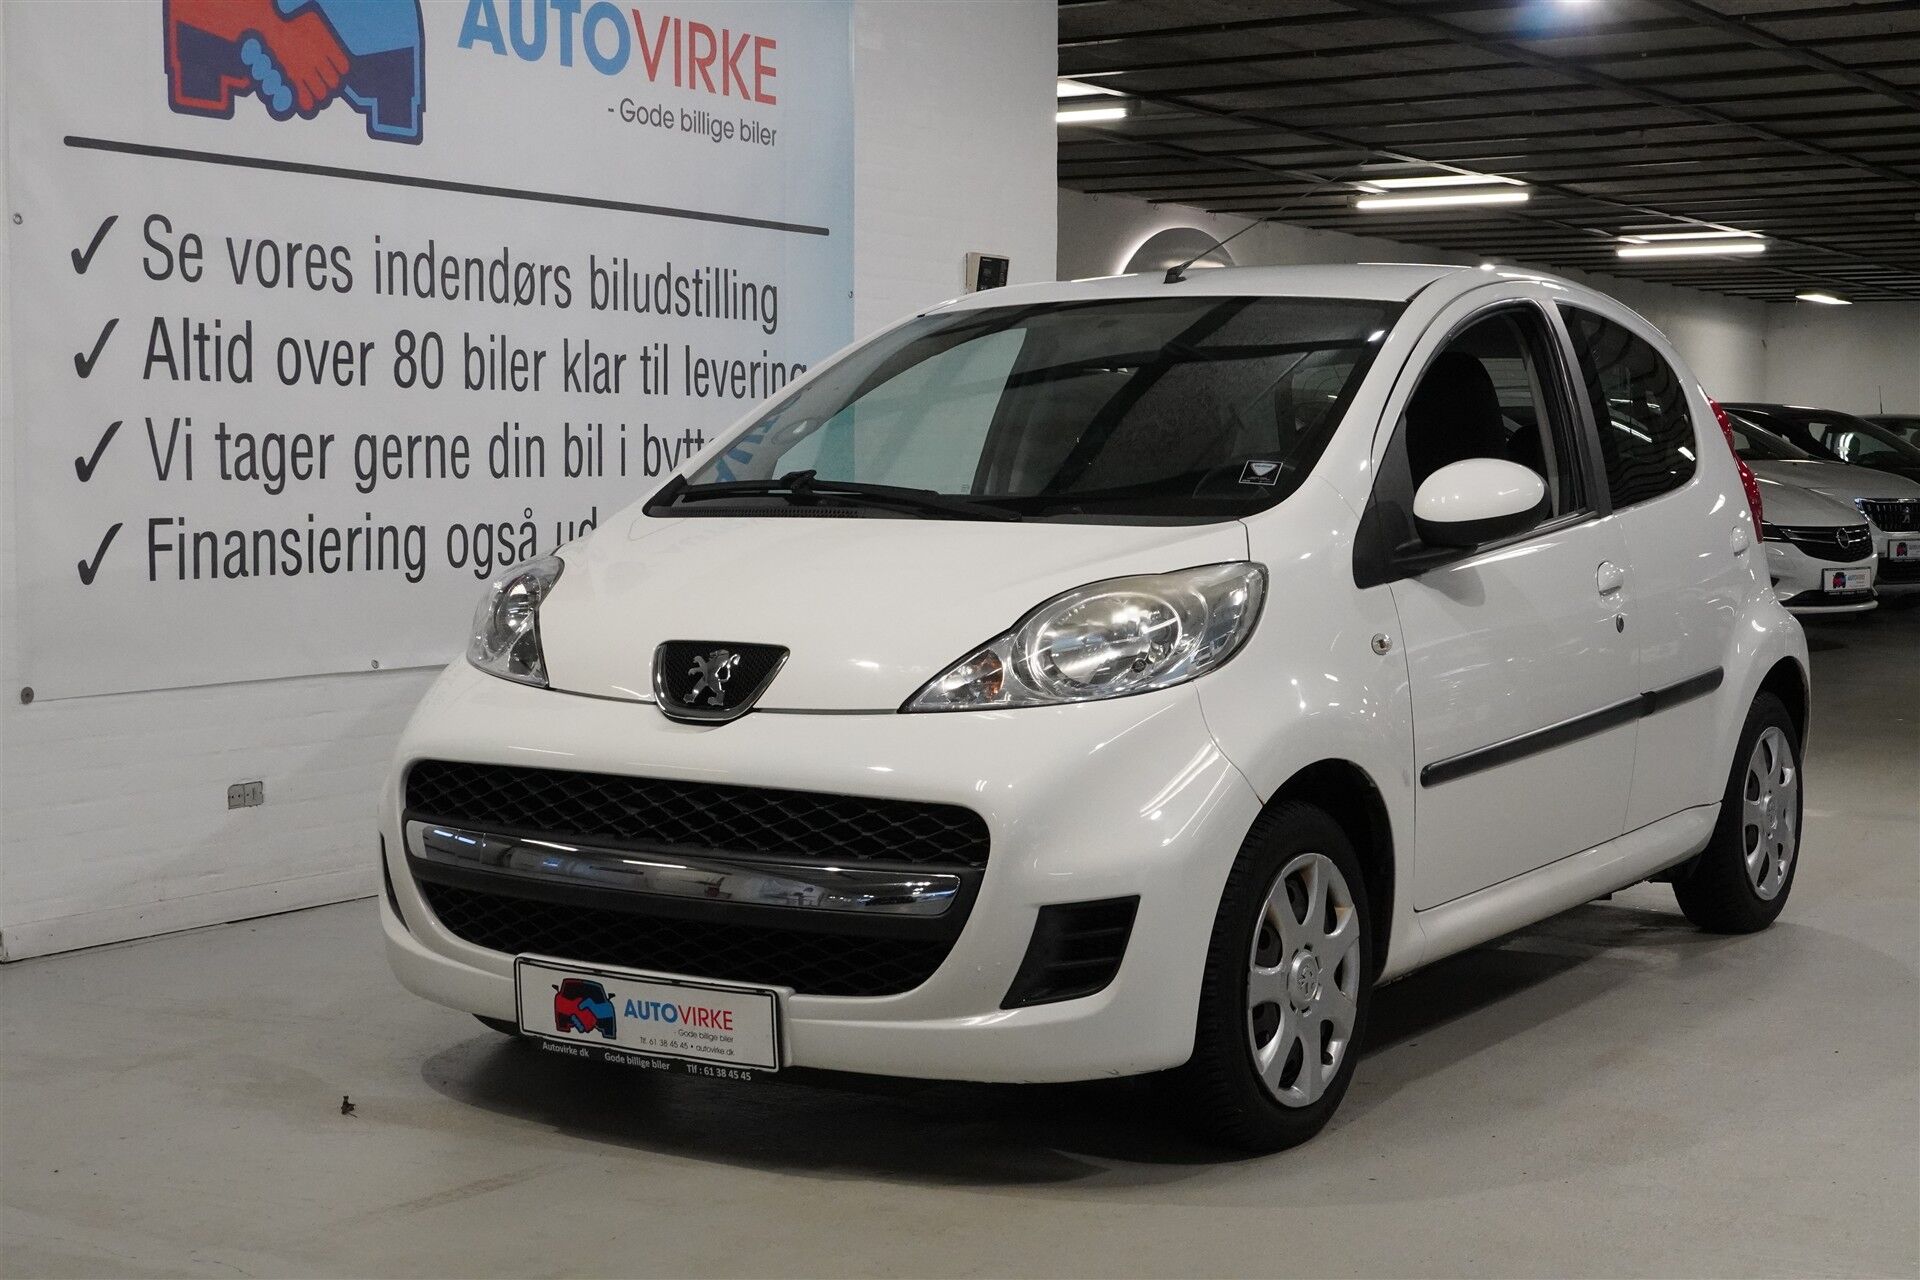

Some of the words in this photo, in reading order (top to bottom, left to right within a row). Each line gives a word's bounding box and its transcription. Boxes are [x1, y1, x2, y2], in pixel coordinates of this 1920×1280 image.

[457, 0, 777, 106] AUTOVIRKE
[619, 97, 675, 129] Gode
[680, 107, 735, 143] billige
[740, 118, 777, 147] biler
[143, 214, 203, 283] Se
[225, 236, 354, 294] vores
[374, 234, 572, 309] indendørs
[590, 254, 778, 336] biludstilling
[142, 317, 253, 384] Altid
[276, 336, 375, 387] over
[393, 329, 444, 390] 80
[463, 331, 547, 393] biler
[563, 337, 627, 396] klar
[639, 343, 669, 397] til
[145, 416, 193, 482] Vi
[214, 422, 335, 496] tager
[354, 433, 470, 495] gerne
[488, 421, 545, 480] din
[564, 422, 603, 479] bil
[620, 423, 626, 477] i
[148, 511, 426, 584] Finansiering
[446, 507, 537, 581] også
[624, 999, 734, 1031] AUTOVIRKE
[649, 1038, 657, 1046] 61
[660, 1039, 668, 1047] 38
[669, 1040, 679, 1049] 45
[680, 1042, 689, 1050] 45
[604, 1052, 625, 1064] Gode
[626, 1055, 650, 1069] billige
[651, 1059, 671, 1071] biler
[703, 1066, 715, 1077] 61
[715, 1067, 727, 1078] 38
[728, 1069, 740, 1080] 45
[740, 1071, 752, 1082] 45
